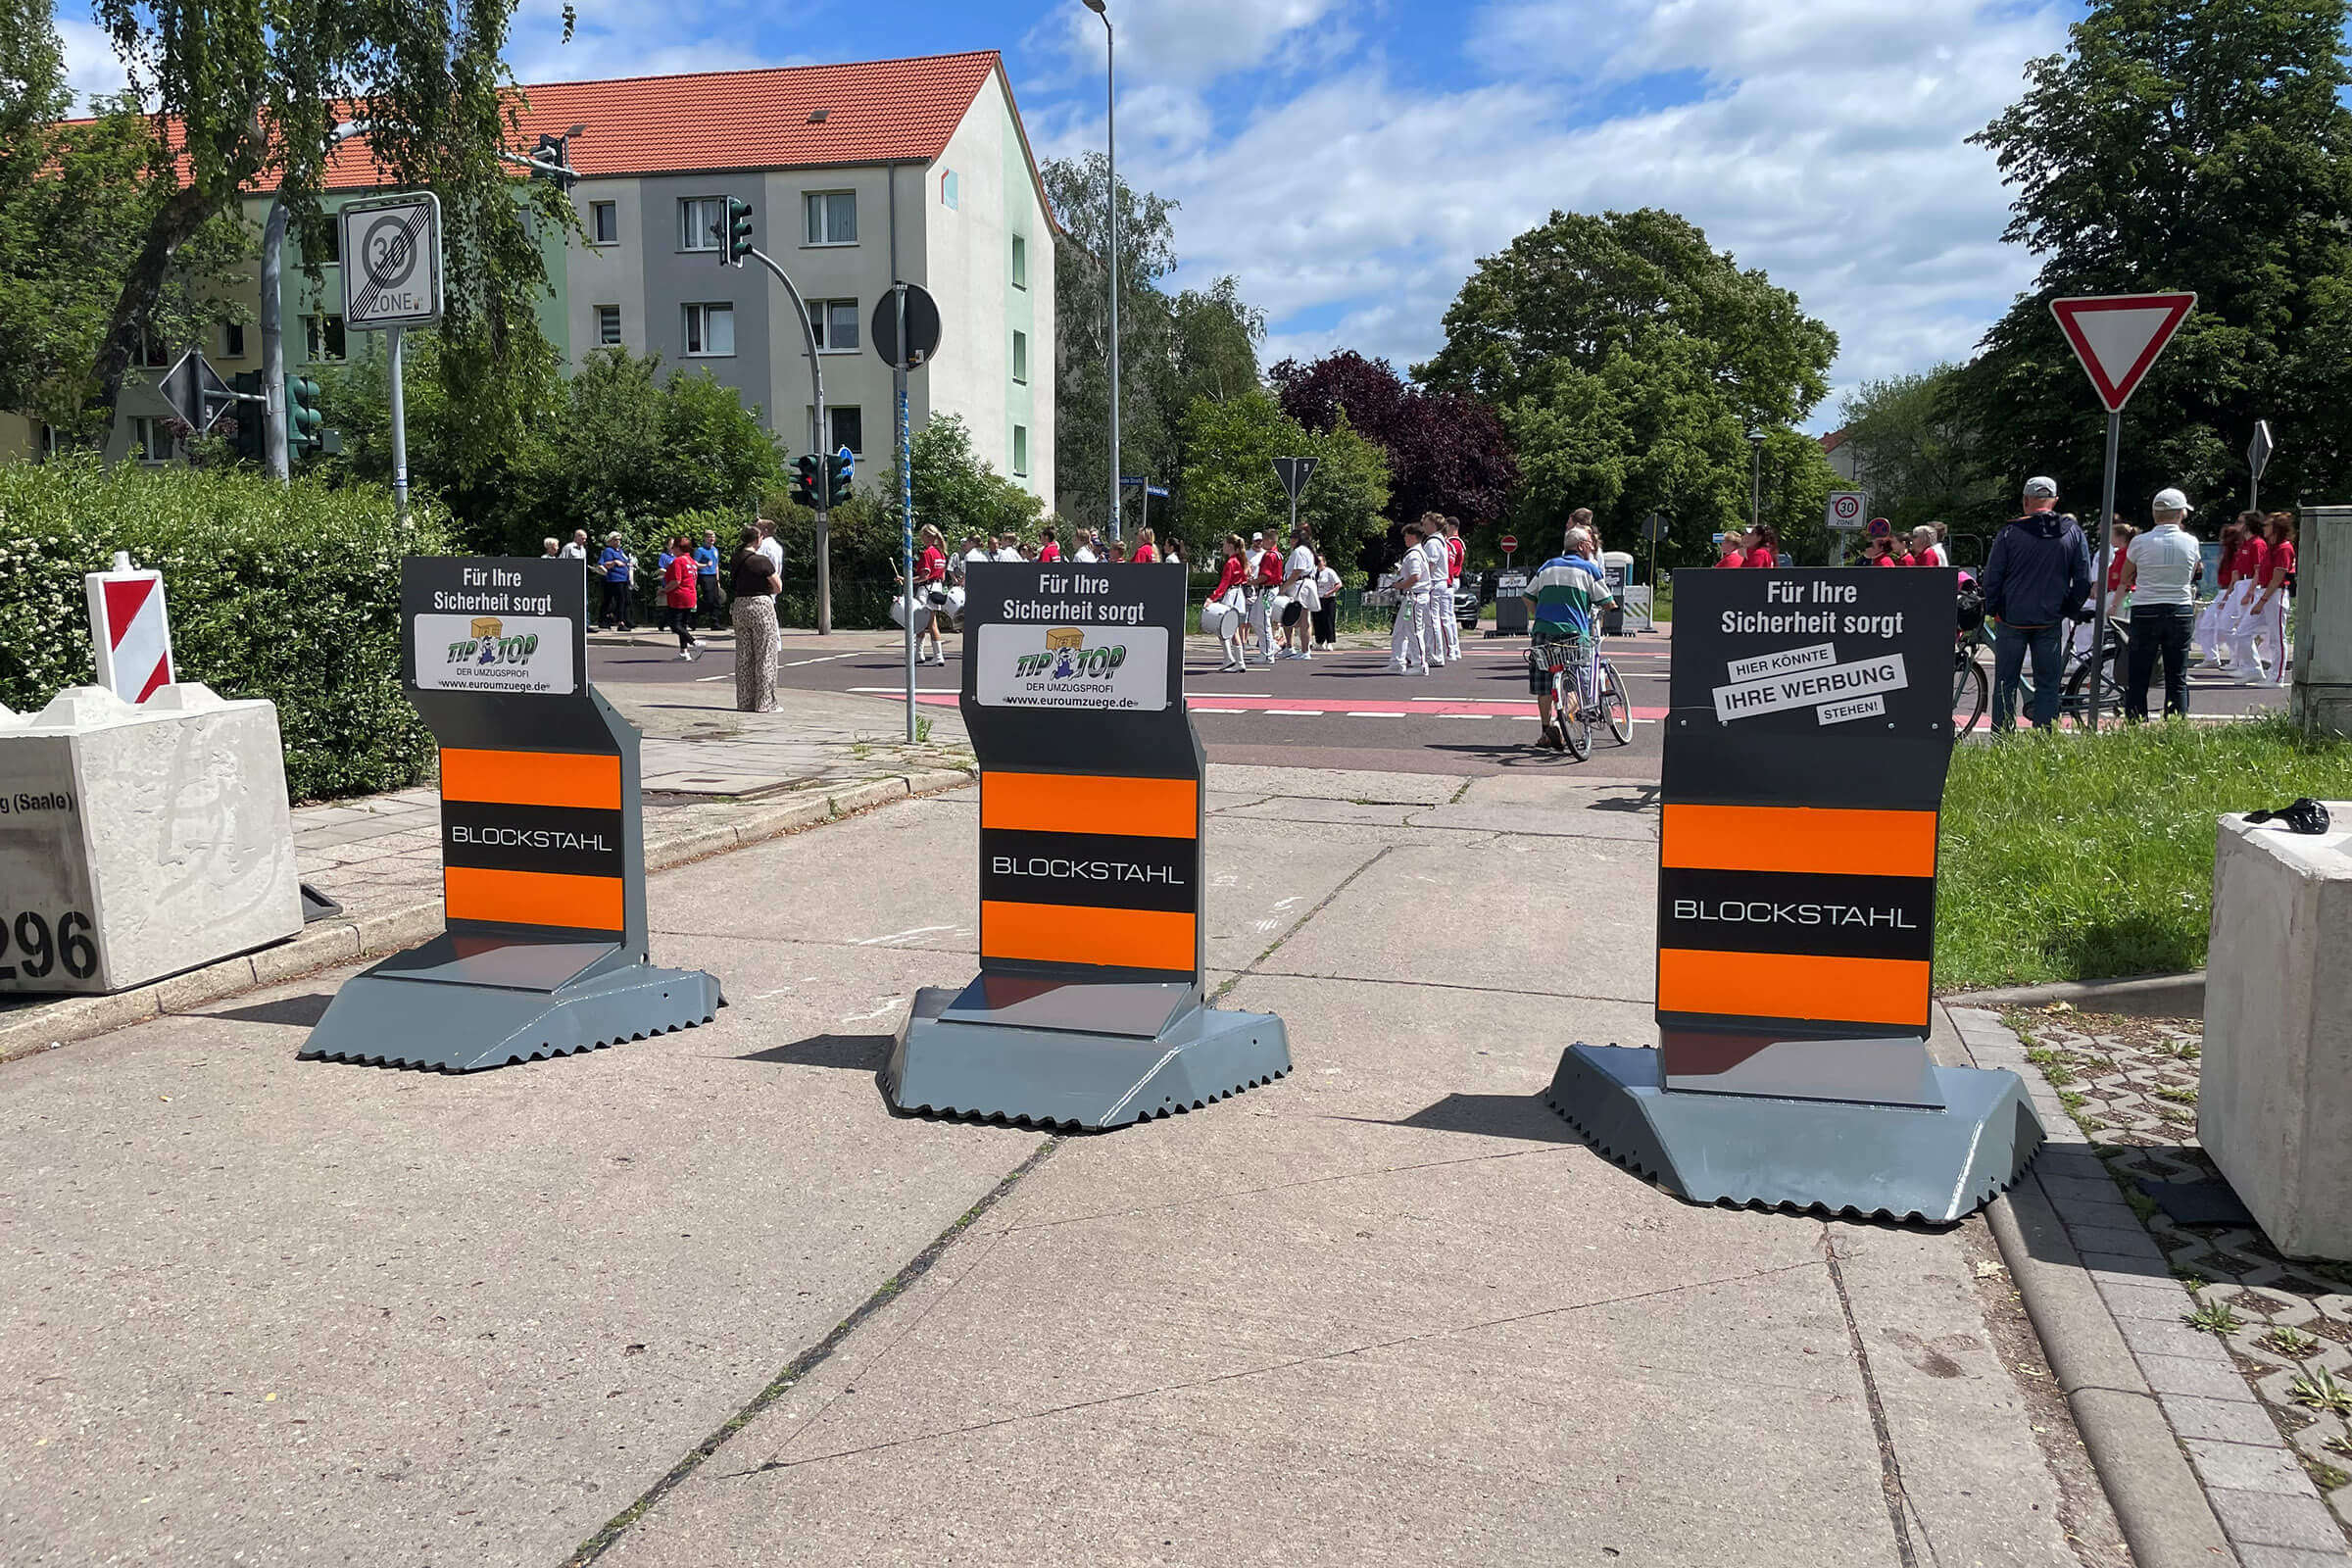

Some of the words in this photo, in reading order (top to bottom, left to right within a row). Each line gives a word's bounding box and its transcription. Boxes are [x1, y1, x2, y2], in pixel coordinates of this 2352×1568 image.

[371, 293, 413, 313] ZONE
[1839, 502, 1854, 513] 30
[464, 568, 487, 586] Für
[493, 568, 521, 587] Ihre
[1040, 574, 1068, 594] Für
[1075, 574, 1109, 594] Ihre
[434, 591, 509, 611] Sicherheit
[514, 595, 552, 614] sorgt
[1767, 581, 1804, 603] Für
[1813, 581, 1857, 603] Ihre
[1004, 600, 1093, 620] Sicherheit
[1099, 602, 1145, 624] sorgt
[1722, 611, 1837, 633] Sicherheit
[1843, 612, 1904, 638] sorgt
[447, 640, 478, 663] TIP
[494, 633, 538, 666] TOP
[474, 668, 529, 677] UMZUGSPROFI
[1015, 652, 1053, 678] TIP
[1074, 645, 1126, 680] TOP
[1736, 661, 1773, 676] HIER
[1772, 649, 1829, 668] KÖNNTE
[441, 680, 547, 692] www.euroumzuege.de
[1026, 683, 1045, 692] DER
[1047, 683, 1113, 693] UMZUGSPROFI
[1725, 687, 1777, 710] IHRE
[1782, 664, 1895, 699] WERBUNG
[1006, 696, 1134, 709] www.euroumzuege.de
[1824, 702, 1879, 718] STEHEN!
[14, 791, 73, 814] (Saale)
[452, 826, 612, 852] BLOCKSTAHL
[993, 857, 1185, 884] BLOCKSTAHL
[1674, 900, 1917, 928] BLOCKSTAHL
